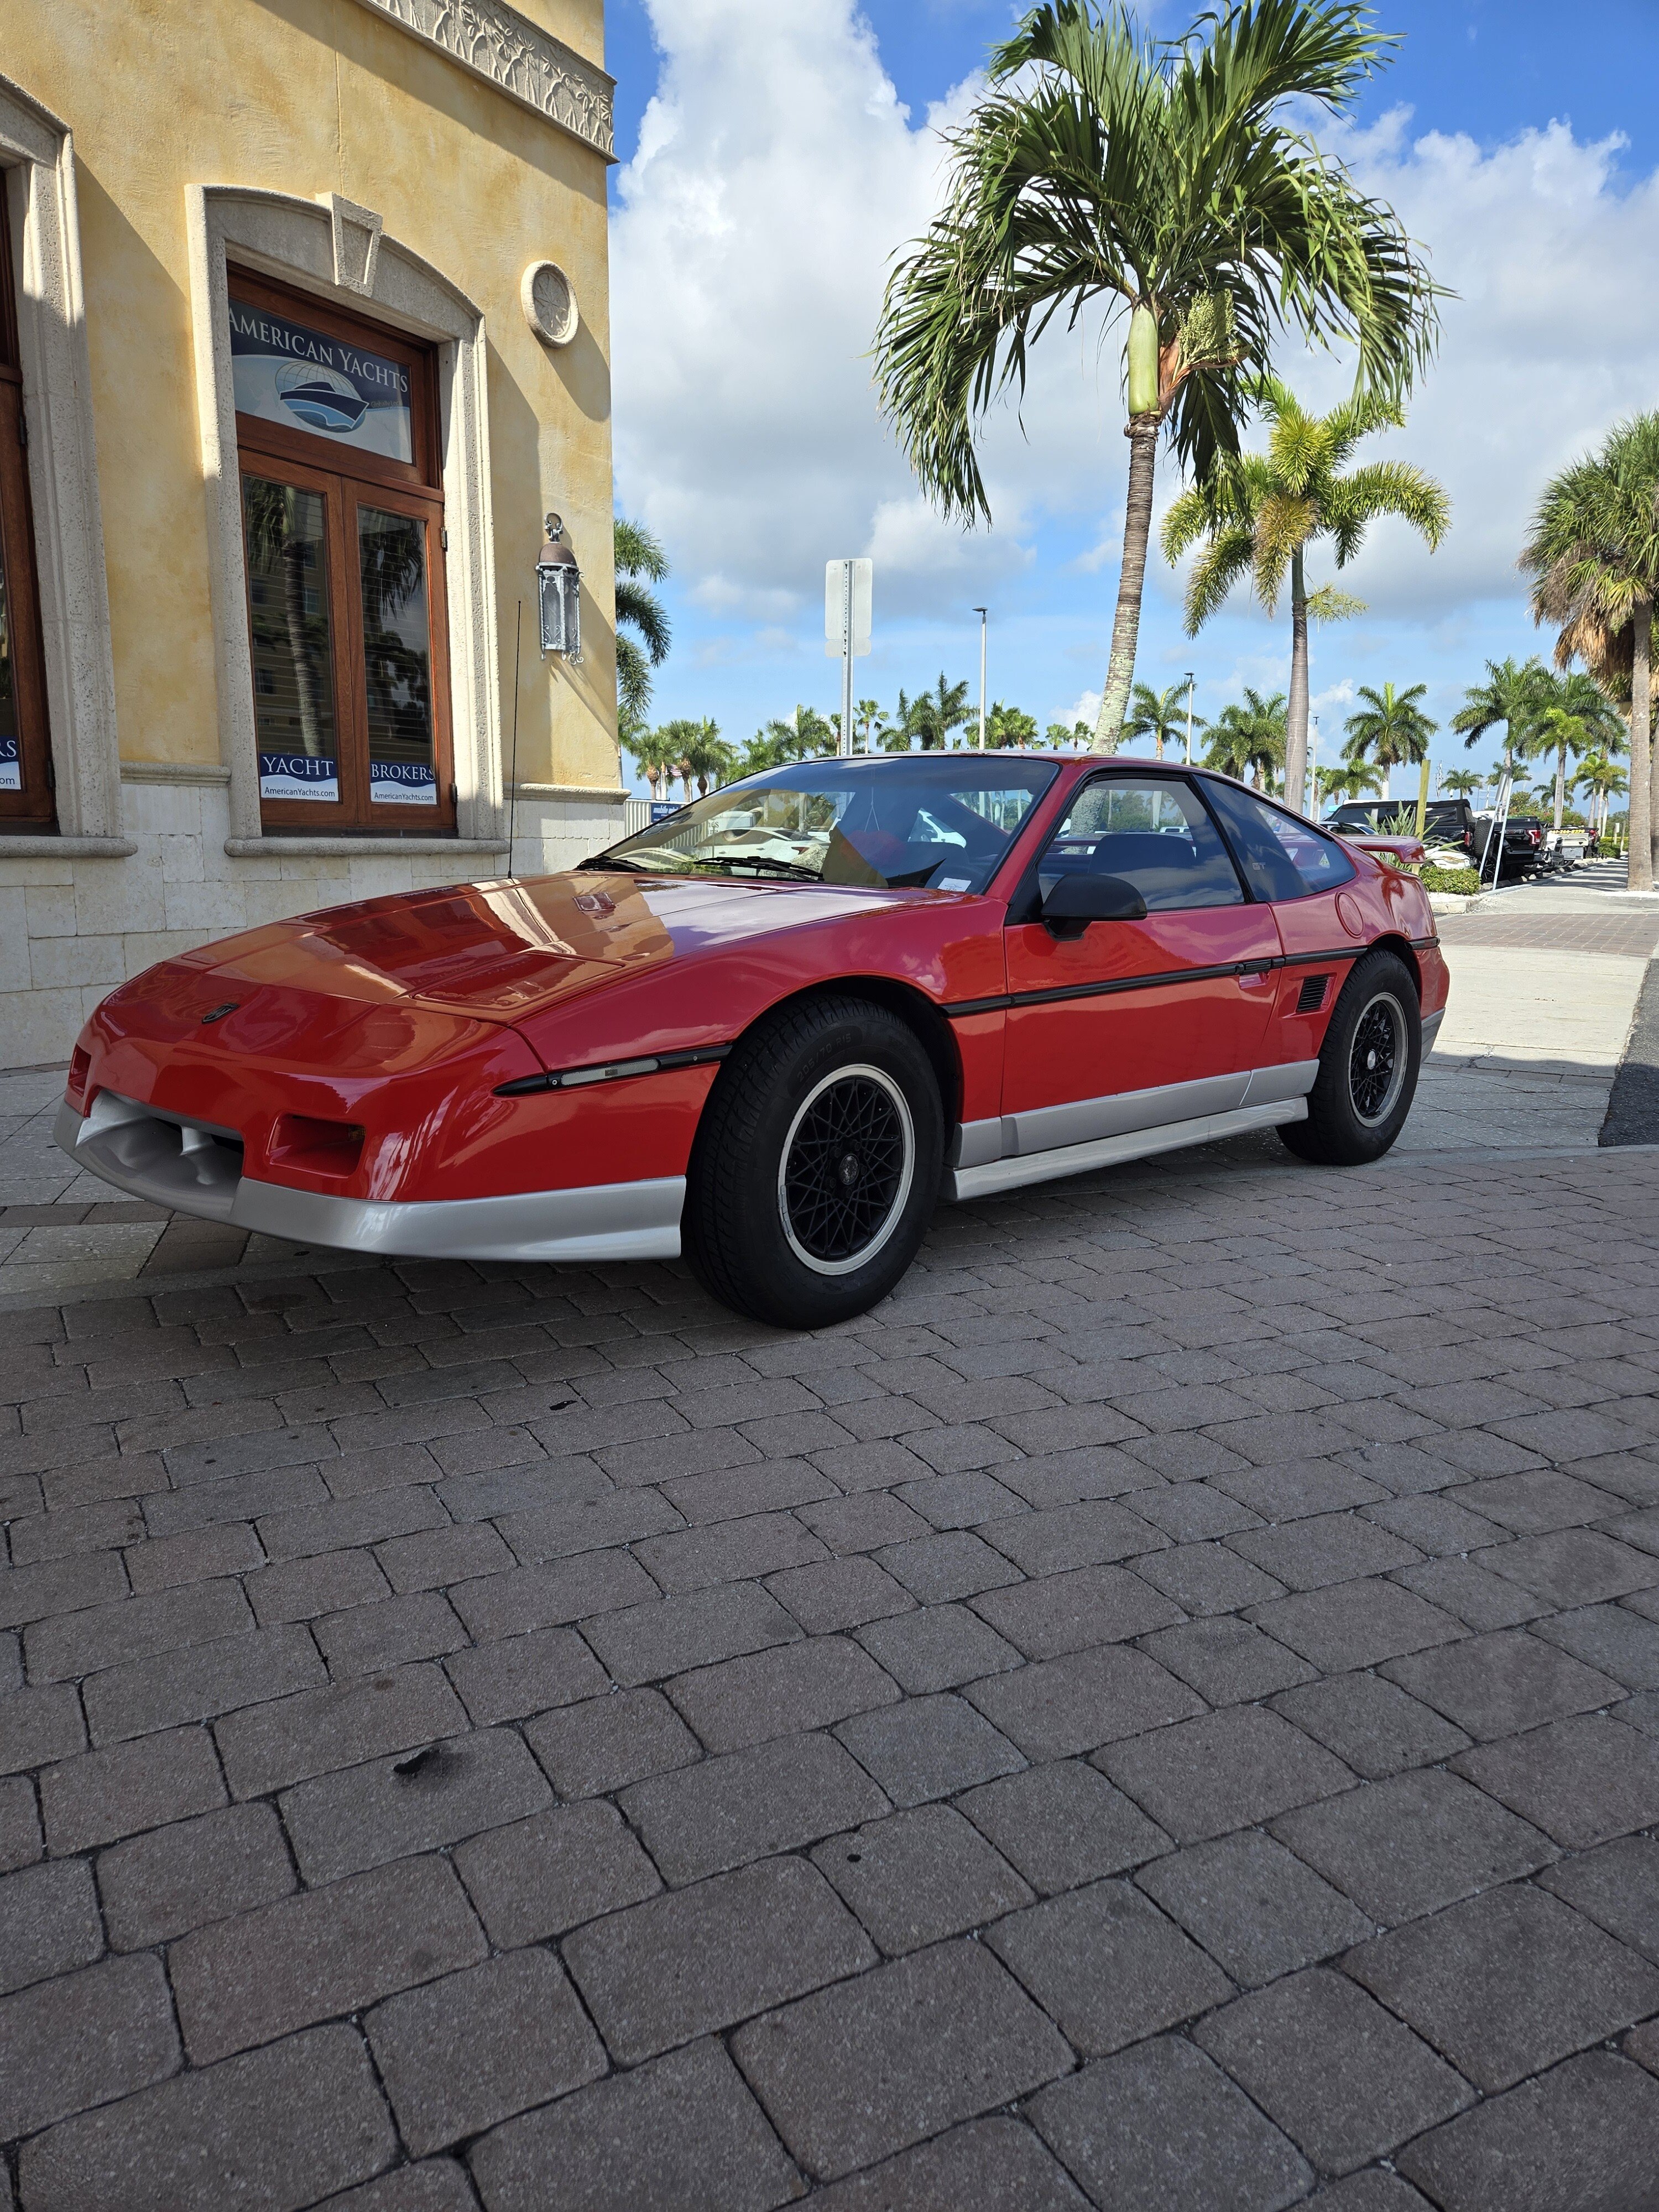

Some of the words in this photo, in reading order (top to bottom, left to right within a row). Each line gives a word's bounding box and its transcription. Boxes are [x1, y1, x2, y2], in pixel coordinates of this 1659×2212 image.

[228, 307, 333, 366] AMERICAN
[338, 348, 408, 393] YACHTS
[263, 757, 333, 776] YACHT
[371, 764, 435, 781] BROKERS
[264, 786, 335, 797] AmericanYachts.com
[374, 792, 434, 801] AmericanYachts.com
[1252, 862, 1266, 870] GT
[796, 1042, 832, 1083] 205/70
[836, 1032, 852, 1047] R15
